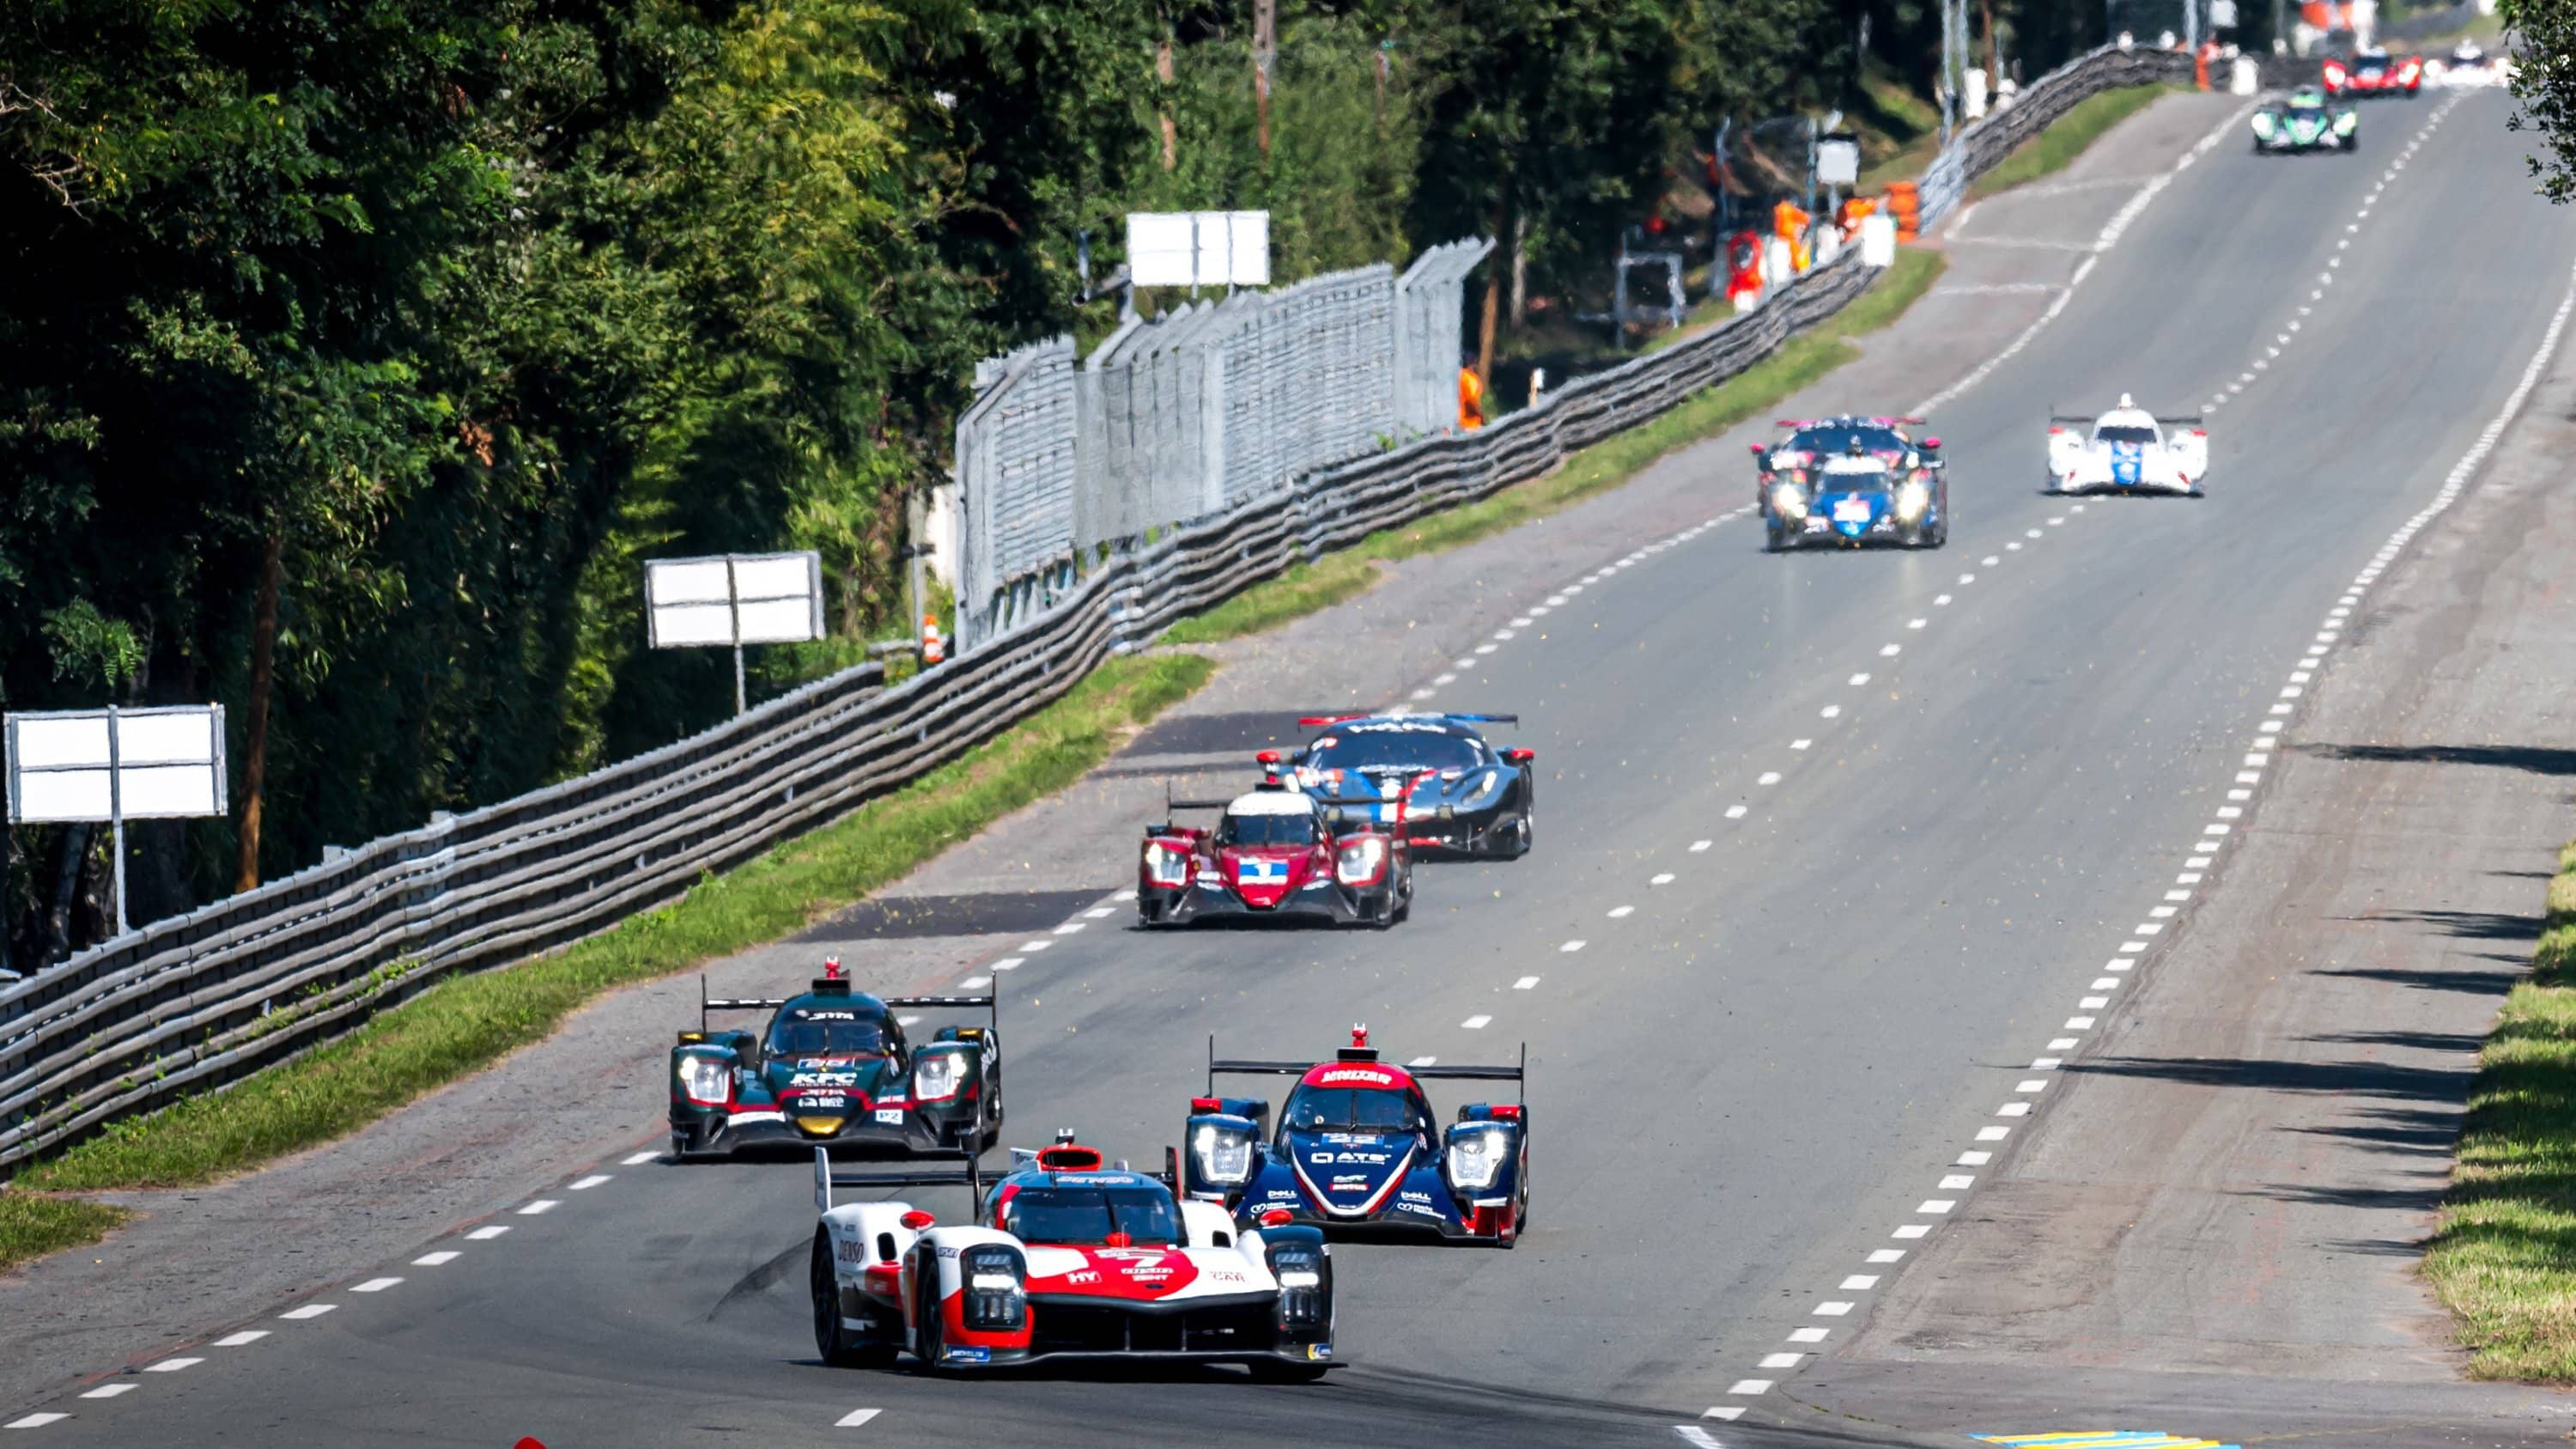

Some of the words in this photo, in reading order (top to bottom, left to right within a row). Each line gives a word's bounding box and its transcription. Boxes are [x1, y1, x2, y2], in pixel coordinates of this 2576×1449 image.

[790, 1073, 857, 1084] KFC
[879, 1112, 899, 1122] P2
[838, 1239, 865, 1263] DENSO
[1068, 1271, 1097, 1282] HY
